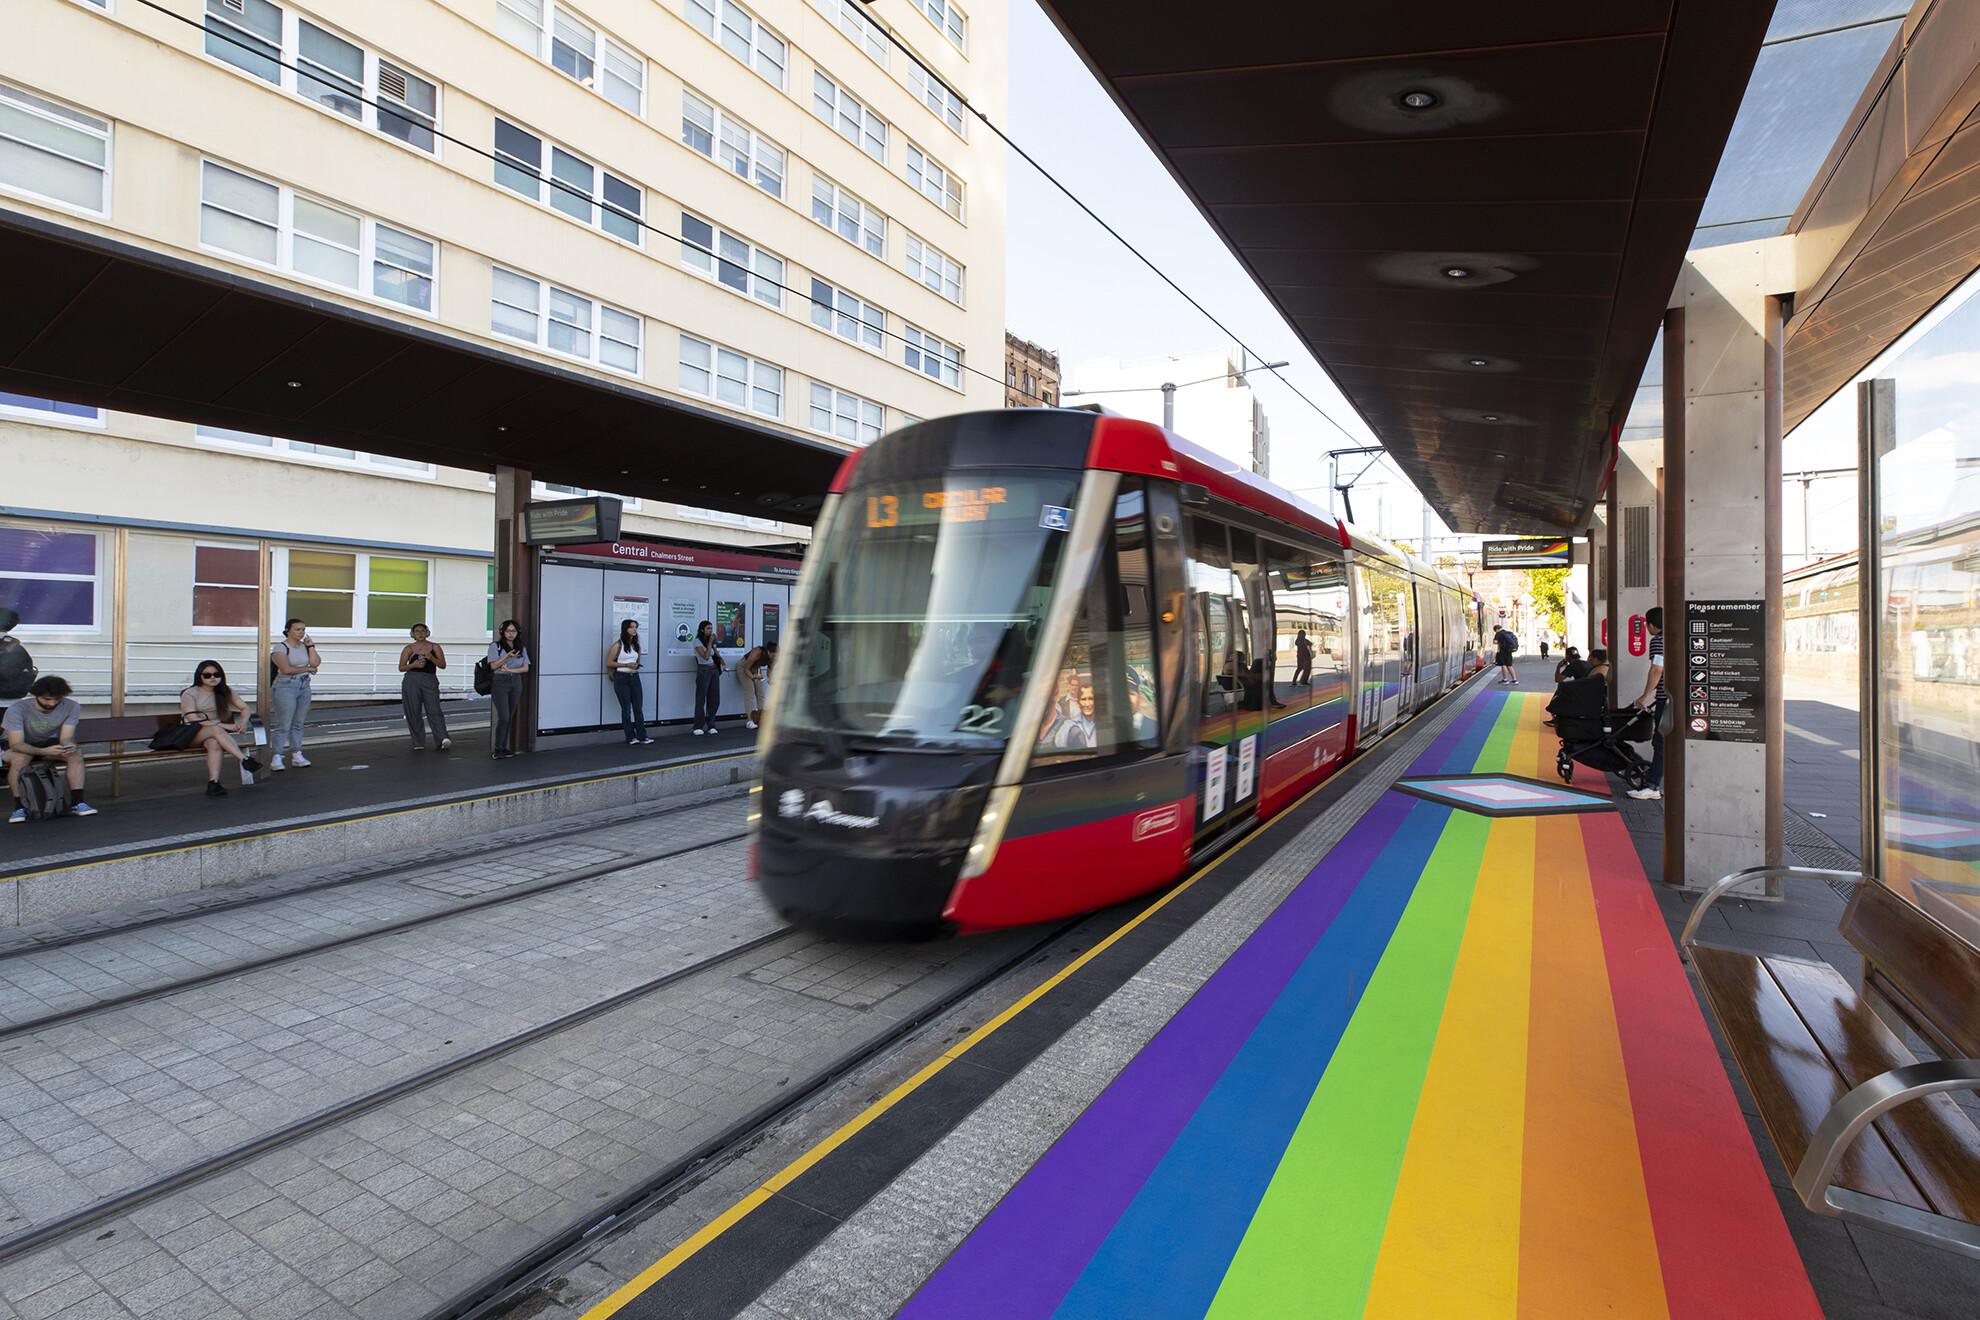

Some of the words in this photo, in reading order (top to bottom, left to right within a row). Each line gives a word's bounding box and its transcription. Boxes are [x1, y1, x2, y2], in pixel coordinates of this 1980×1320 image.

[554, 509, 568, 517] Pride
[867, 495, 899, 528] L3
[612, 543, 648, 557] Central
[650, 551, 677, 560] Chalmers
[677, 554, 695, 562] Street
[1689, 603, 1716, 611] Please
[1717, 603, 1760, 611] remember
[958, 704, 1004, 733] 22
